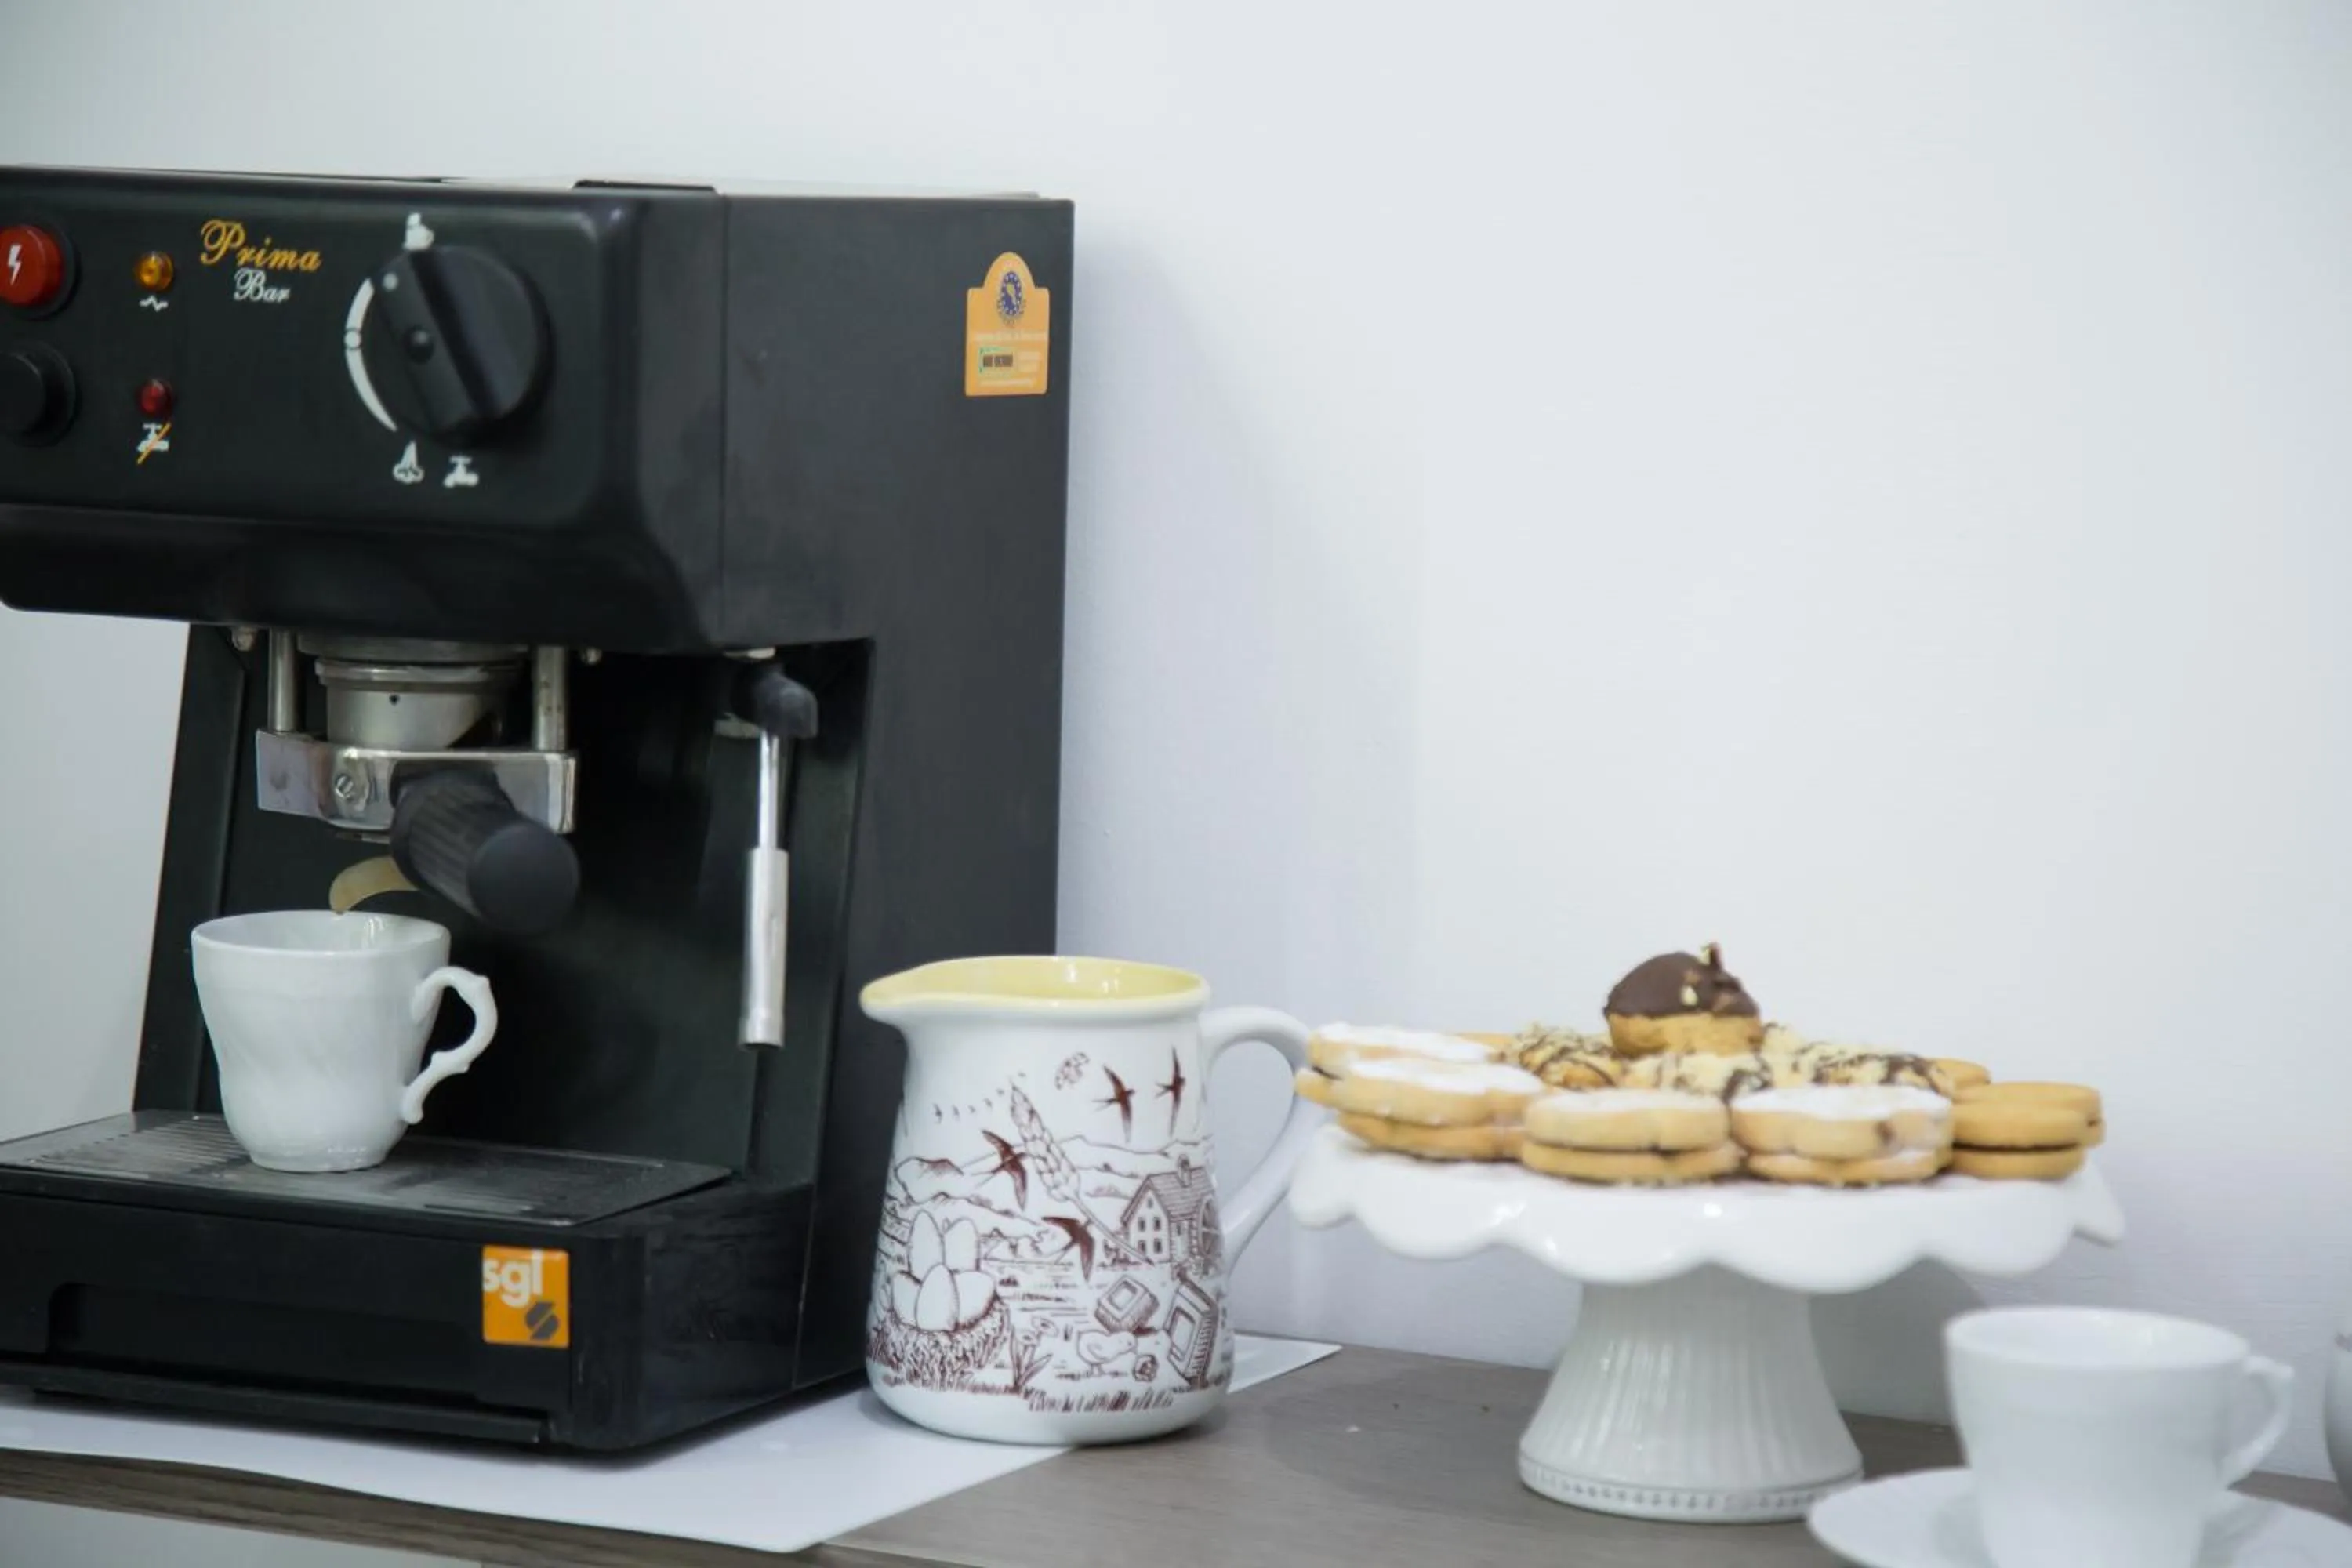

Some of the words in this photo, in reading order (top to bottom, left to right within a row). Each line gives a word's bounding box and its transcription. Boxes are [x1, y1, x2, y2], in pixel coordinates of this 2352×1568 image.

[200, 219, 322, 271] Prima
[234, 267, 291, 303] Bar
[482, 1249, 543, 1308] sgl
